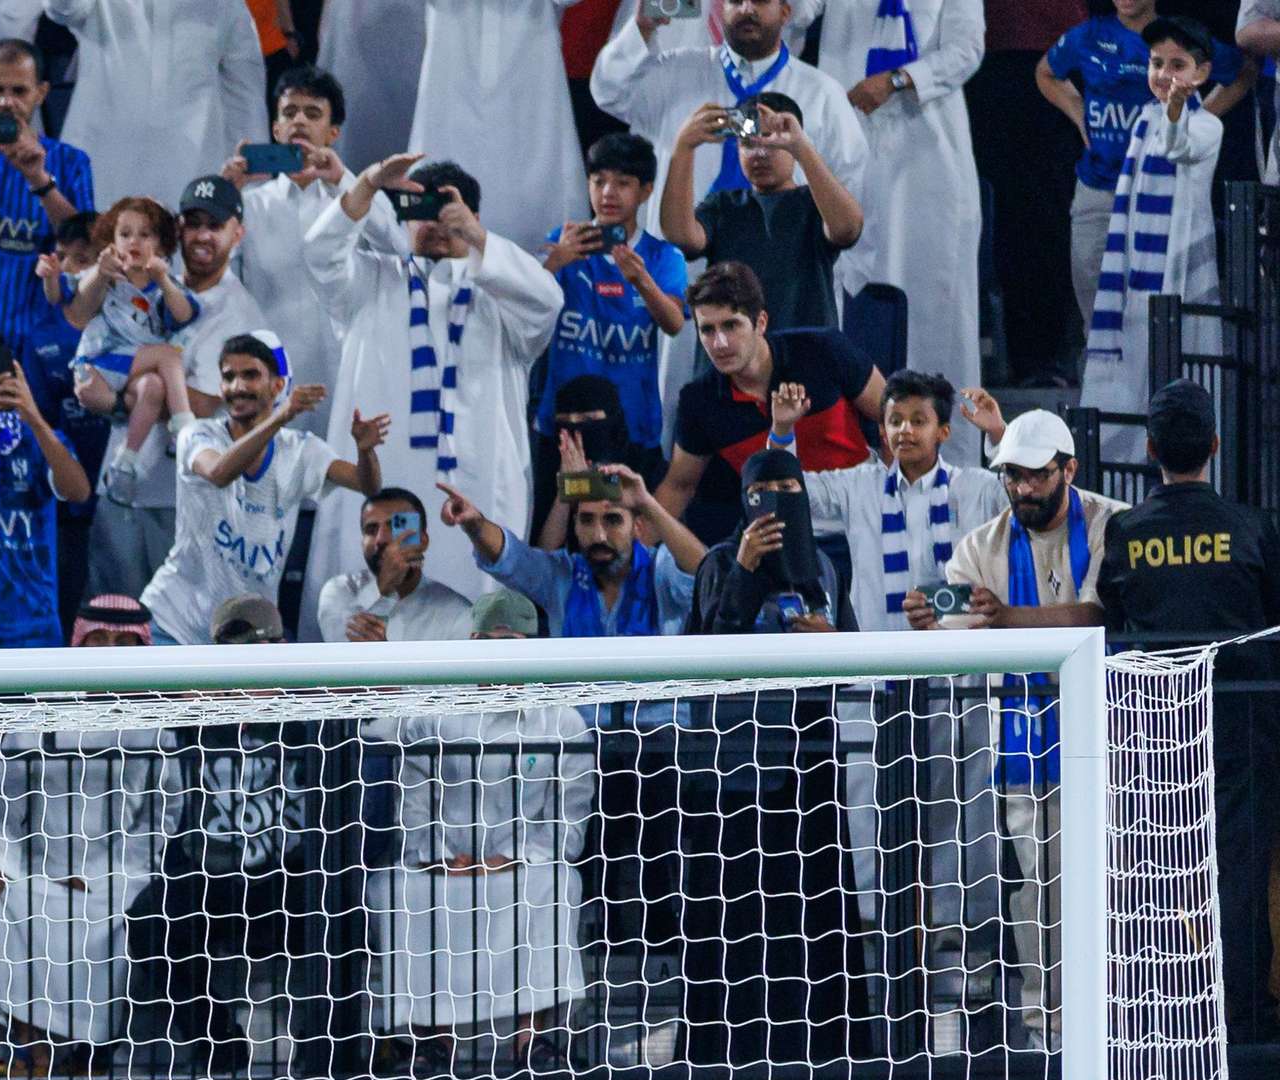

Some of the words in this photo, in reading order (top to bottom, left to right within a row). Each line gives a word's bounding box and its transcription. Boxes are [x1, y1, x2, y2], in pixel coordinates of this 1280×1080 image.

[1089, 100, 1139, 130] SAV
[560, 311, 653, 352] SAVVY
[1128, 533, 1231, 569] POLICE
